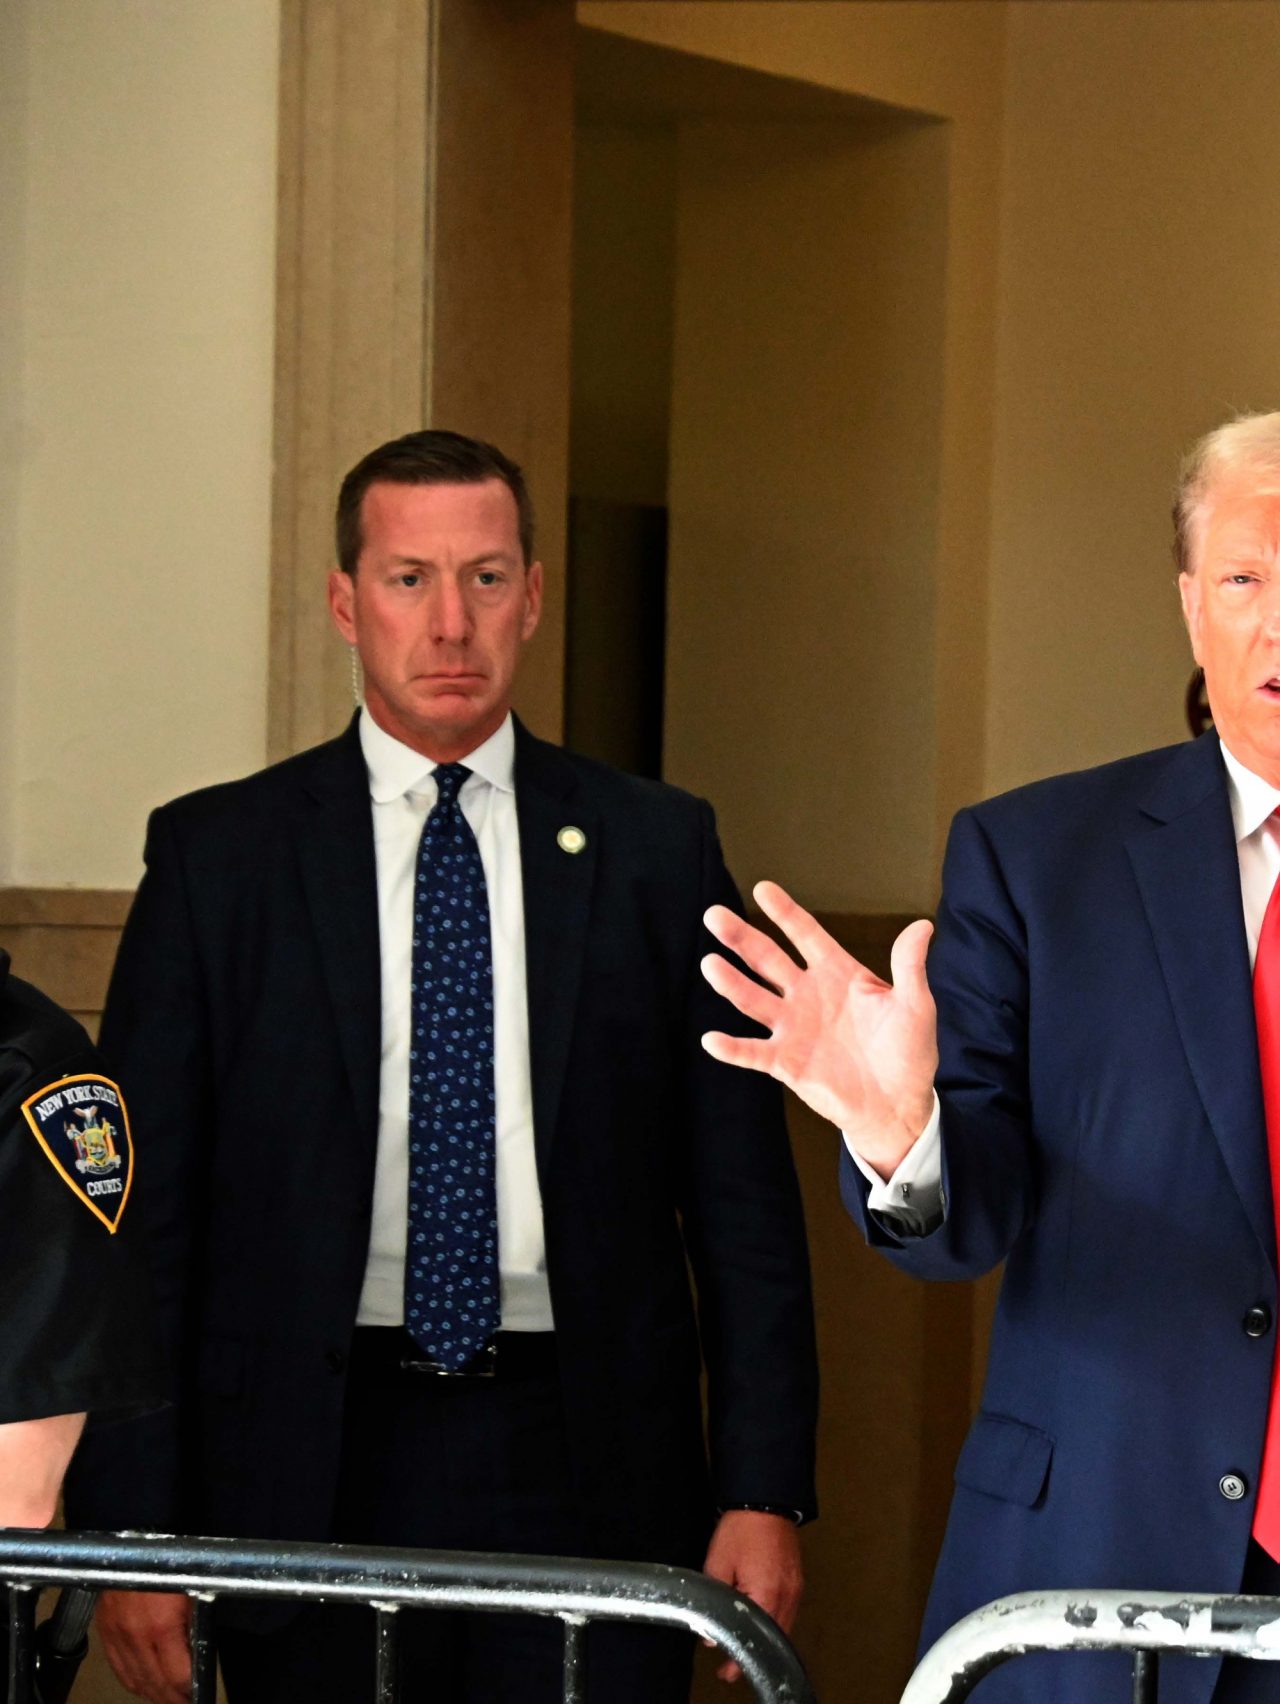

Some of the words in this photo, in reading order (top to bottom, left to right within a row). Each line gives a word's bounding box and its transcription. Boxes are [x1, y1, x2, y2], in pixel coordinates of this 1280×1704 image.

[35, 1092, 64, 1122] NEW
[62, 1085, 94, 1105] YORK
[92, 1085, 119, 1107] STATE
[87, 1177, 122, 1197] COURTS
